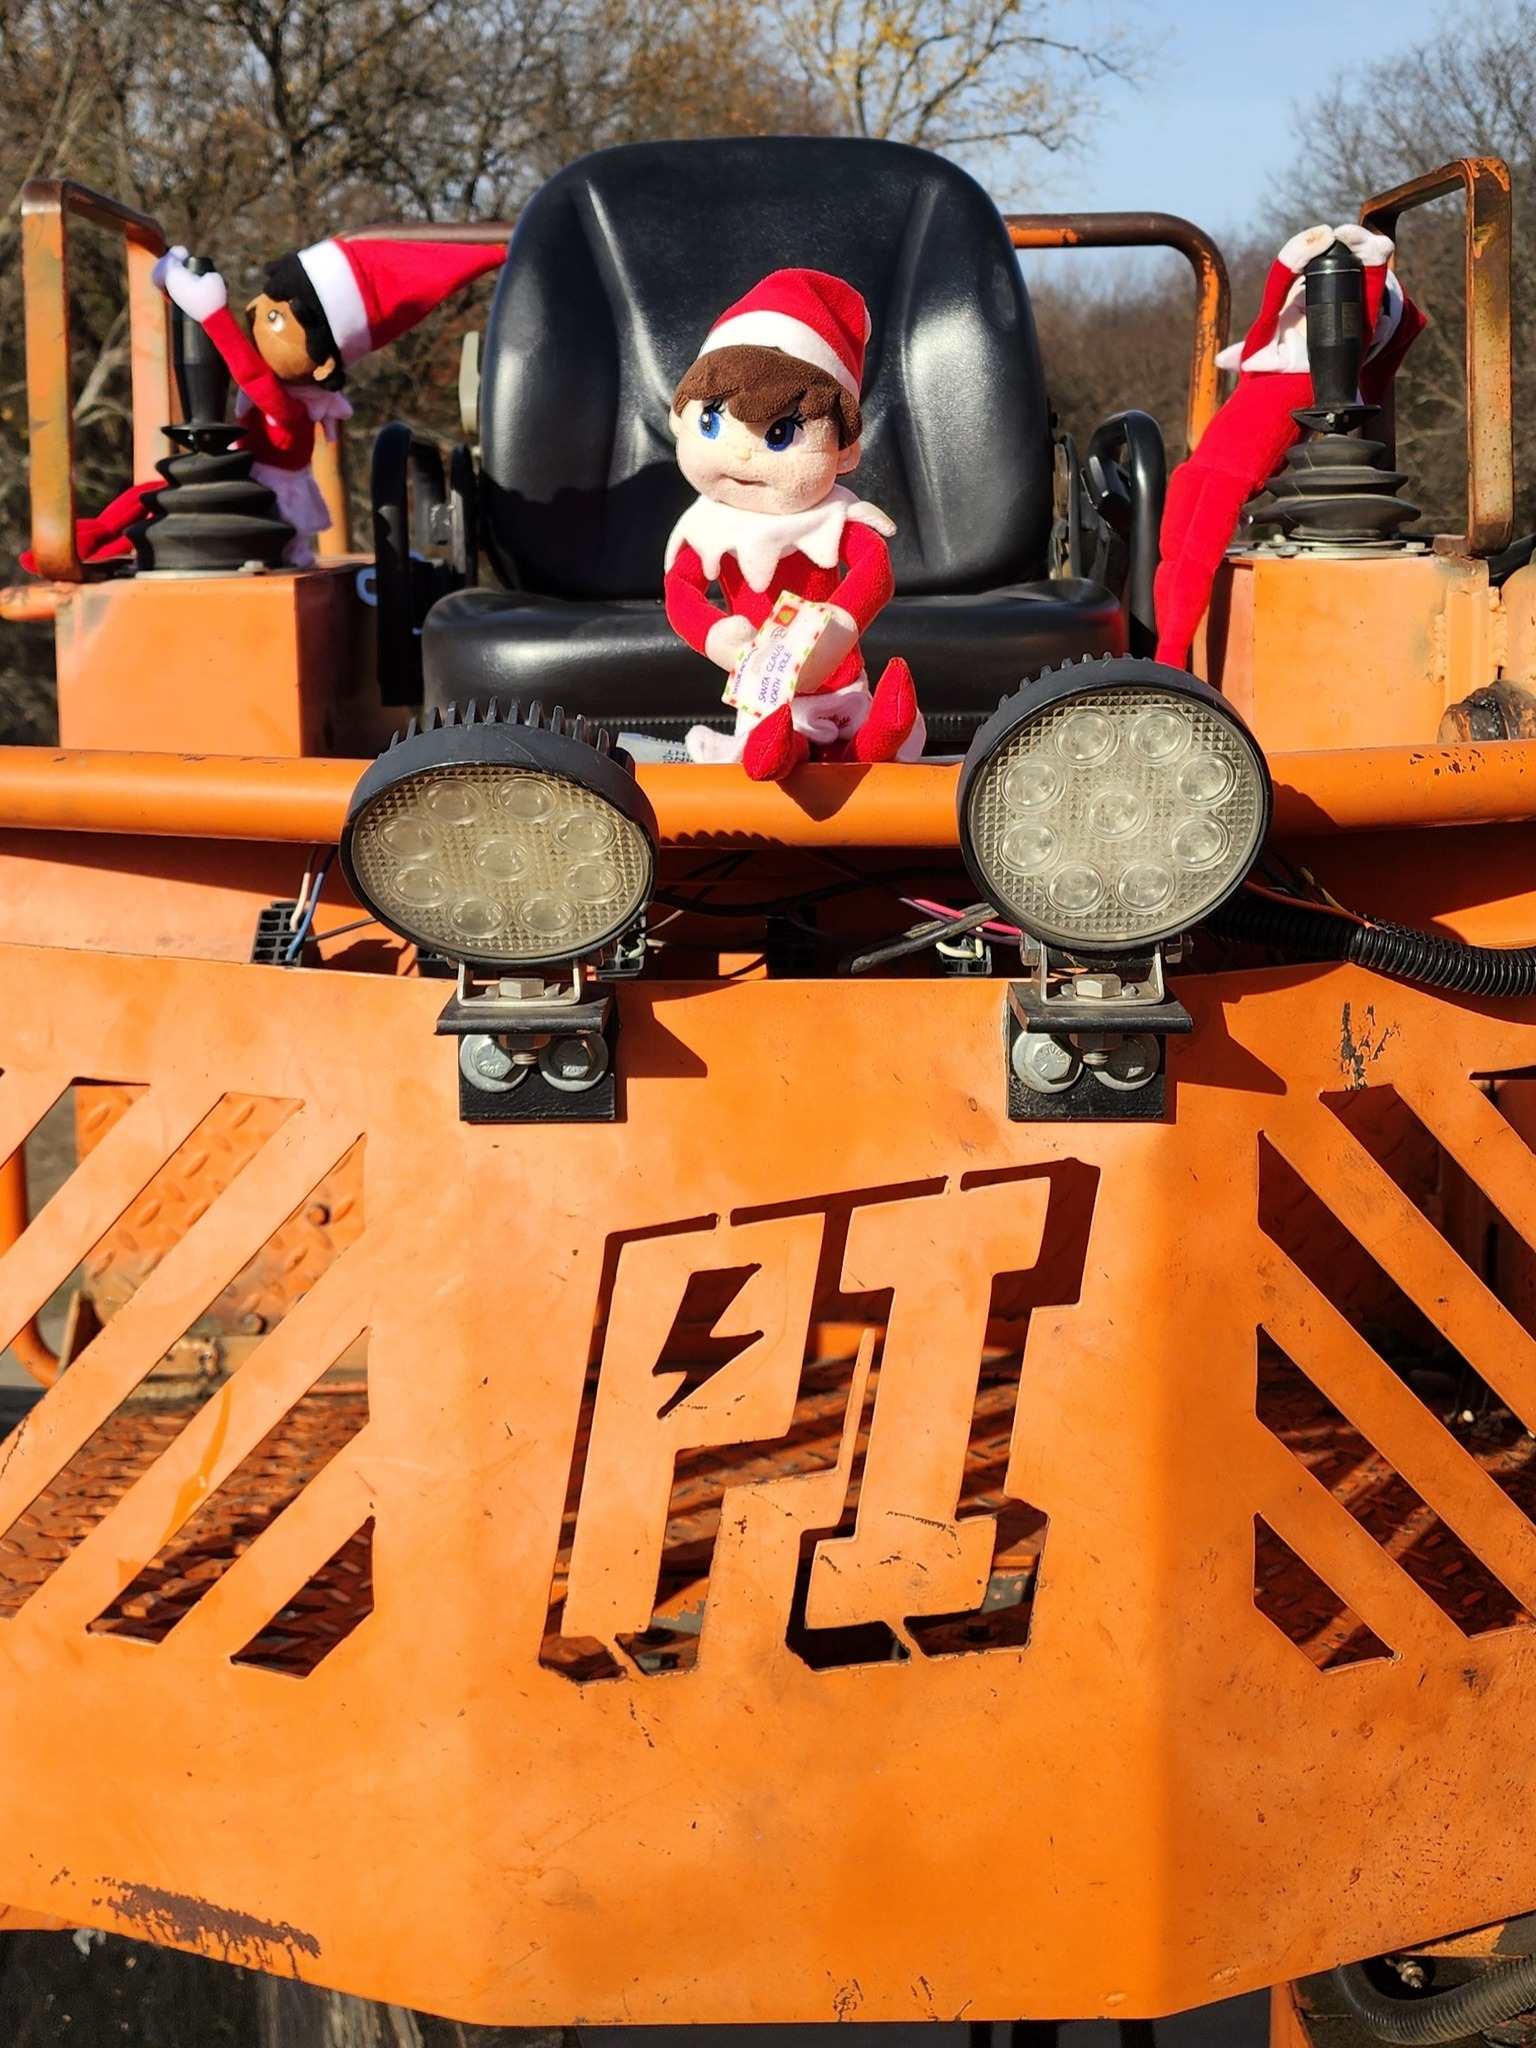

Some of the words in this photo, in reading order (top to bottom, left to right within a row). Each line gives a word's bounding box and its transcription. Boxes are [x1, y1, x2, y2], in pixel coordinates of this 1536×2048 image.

[758, 677, 771, 704] SANTA
[766, 644, 784, 673] CLAUS
[769, 677, 782, 707] NORTH
[777, 651, 792, 673] POLE
[541, 1158, 1100, 1685] PI
